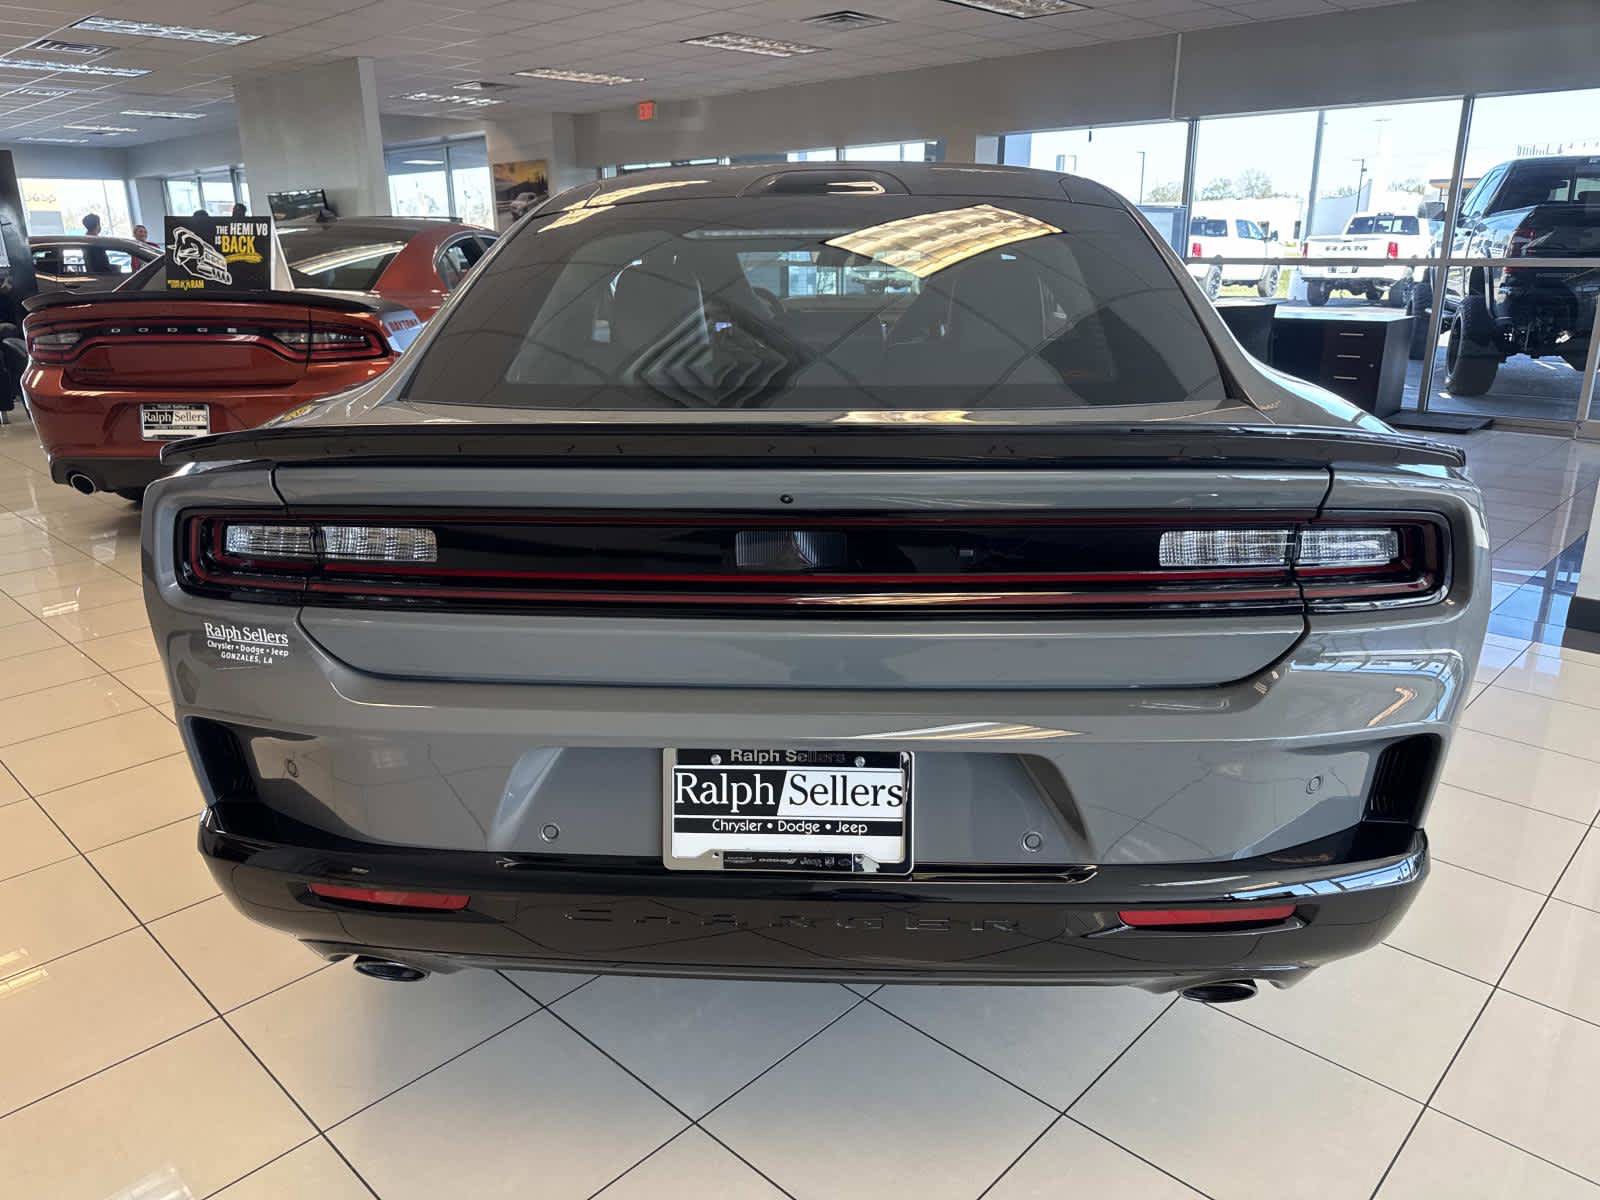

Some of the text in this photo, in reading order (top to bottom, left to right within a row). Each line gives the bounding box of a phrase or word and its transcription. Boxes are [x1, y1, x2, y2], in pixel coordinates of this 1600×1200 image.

[215, 222, 268, 236] THE HEMI V8
[221, 235, 256, 253] BACK
[111, 326, 238, 334] DODGE
[144, 411, 208, 425] Ralph Sellers
[203, 622, 289, 644] Ralph Sellers
[207, 640, 289, 657] Chrysler Dodge Jeep
[221, 651, 273, 664] GONZALES, LA
[730, 749, 780, 764] Ralph
[675, 772, 903, 813] Ralph Sellers
[712, 819, 868, 834] Chrysler Dodge Jeep
[563, 907, 1019, 932] CHARGER
